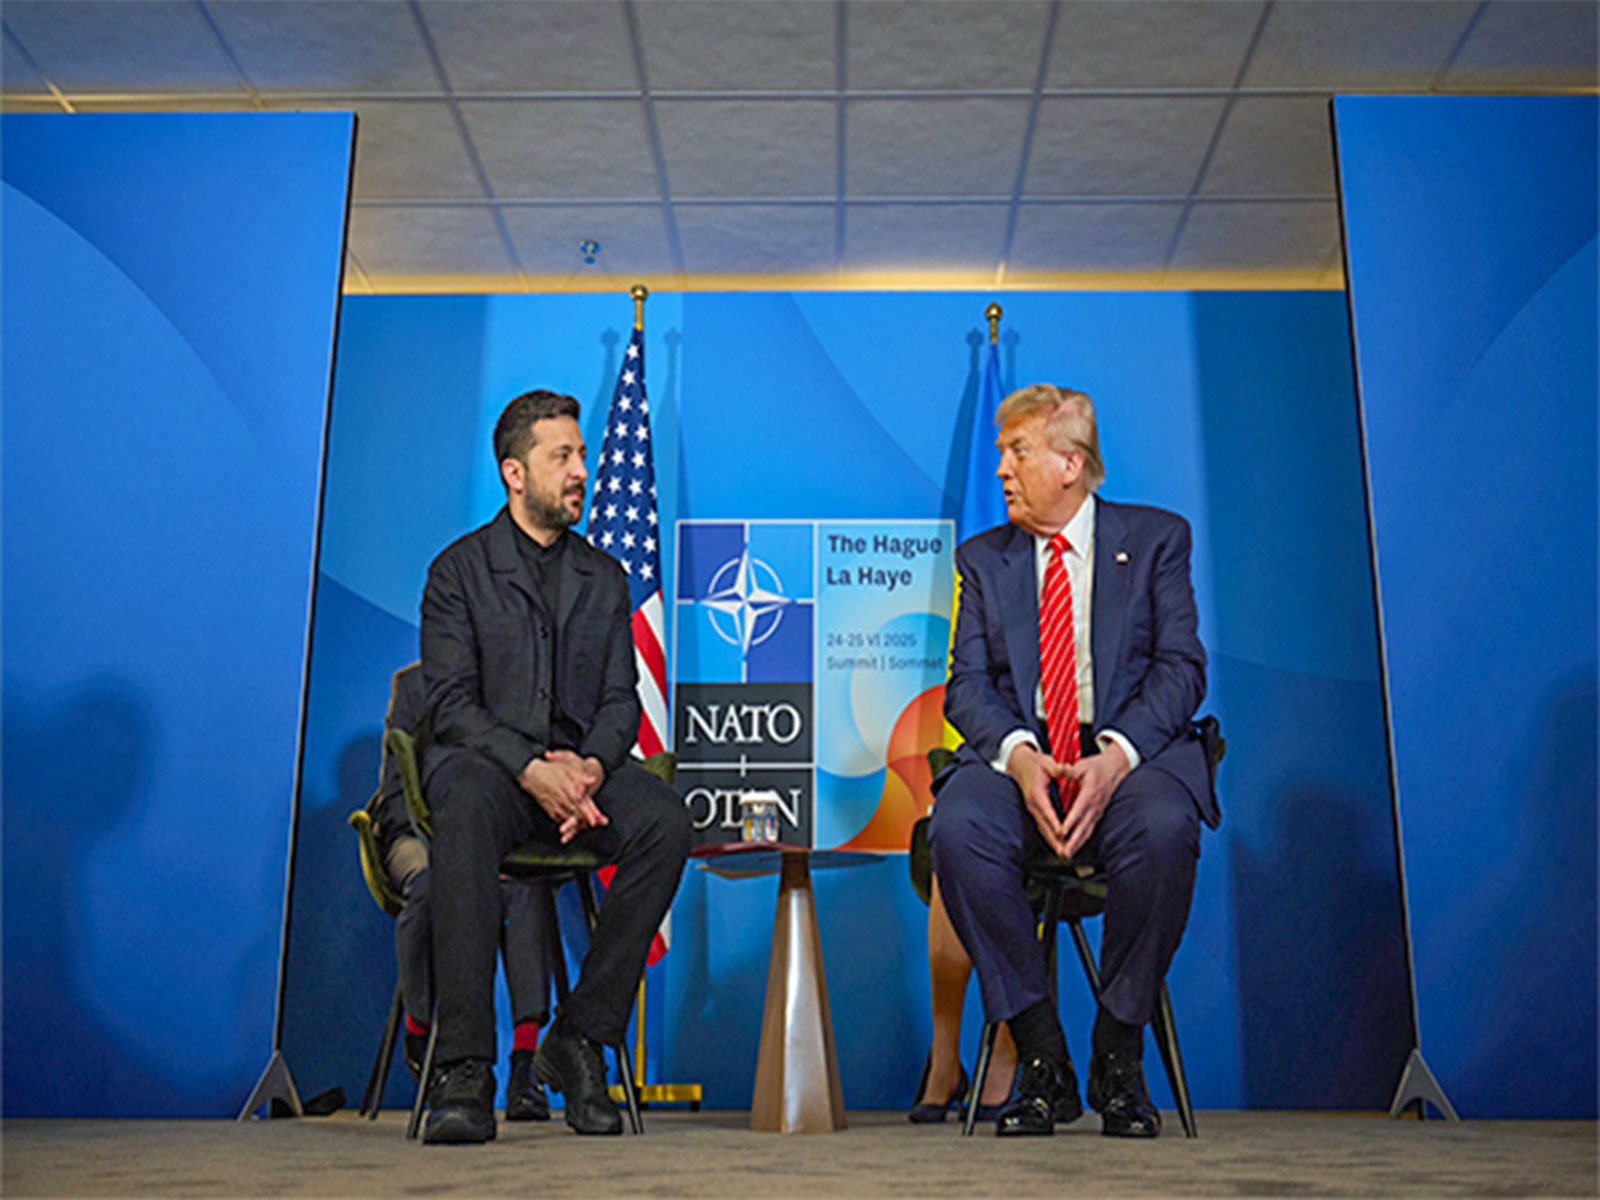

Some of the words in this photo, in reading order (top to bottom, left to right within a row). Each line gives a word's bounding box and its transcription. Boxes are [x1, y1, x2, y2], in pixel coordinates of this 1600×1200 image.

[828, 535, 867, 554] The
[873, 535, 943, 559] Hague
[827, 567, 851, 585] La
[858, 567, 913, 592] Haye
[827, 633, 864, 647] 24-25
[883, 633, 917, 647] 2025
[827, 656, 878, 670] Summit
[888, 656, 944, 670] Sommet
[685, 703, 801, 743] NATO
[685, 788, 801, 829] OTN
